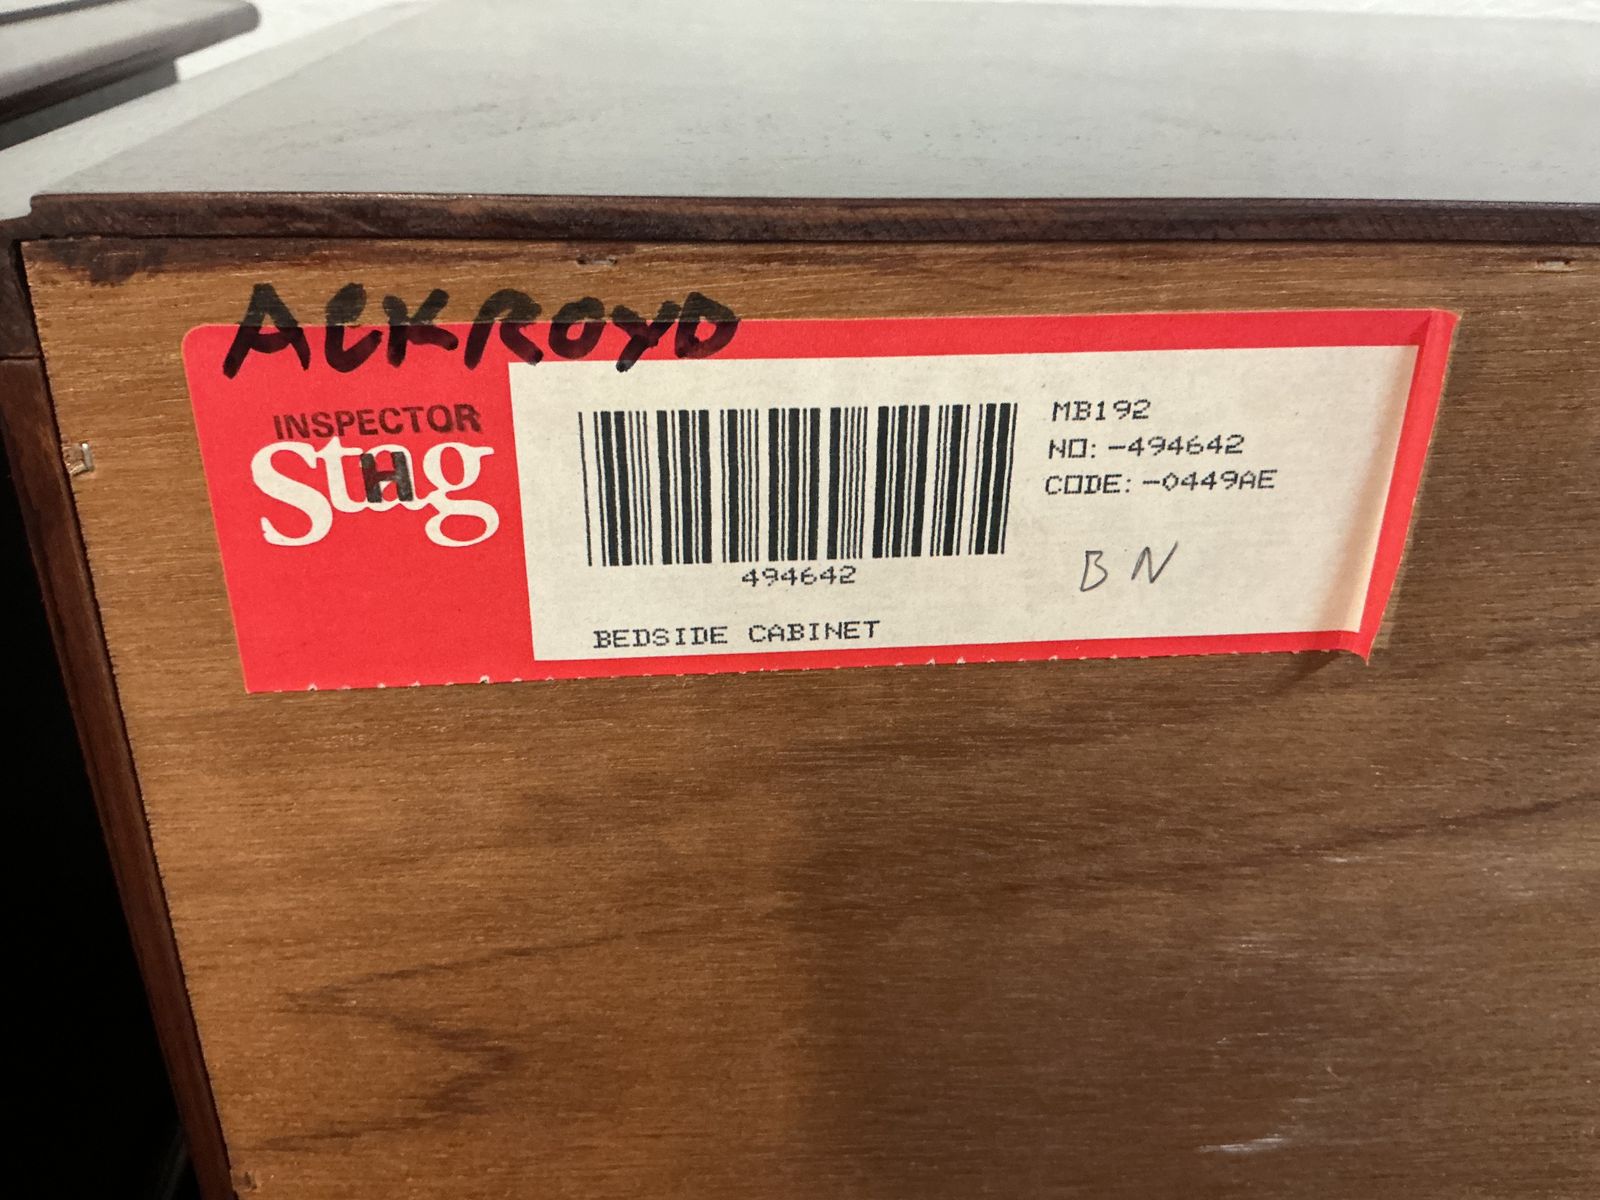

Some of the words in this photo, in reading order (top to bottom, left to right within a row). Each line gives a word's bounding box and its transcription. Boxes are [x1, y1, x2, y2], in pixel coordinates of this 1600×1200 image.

[273, 403, 482, 440] INSPECTOR
[1052, 399, 1151, 422] MB192
[1048, 438, 1096, 460] NO:
[1107, 434, 1245, 457] -494642
[250, 436, 500, 547] Stag
[1045, 474, 1131, 496] CODE:
[1142, 469, 1278, 491] -0449AE
[741, 565, 857, 588] 494642
[1079, 550, 1109, 592] B
[1130, 541, 1179, 584] N
[593, 626, 729, 649] BEDSIDE
[748, 620, 881, 643] CABINET
